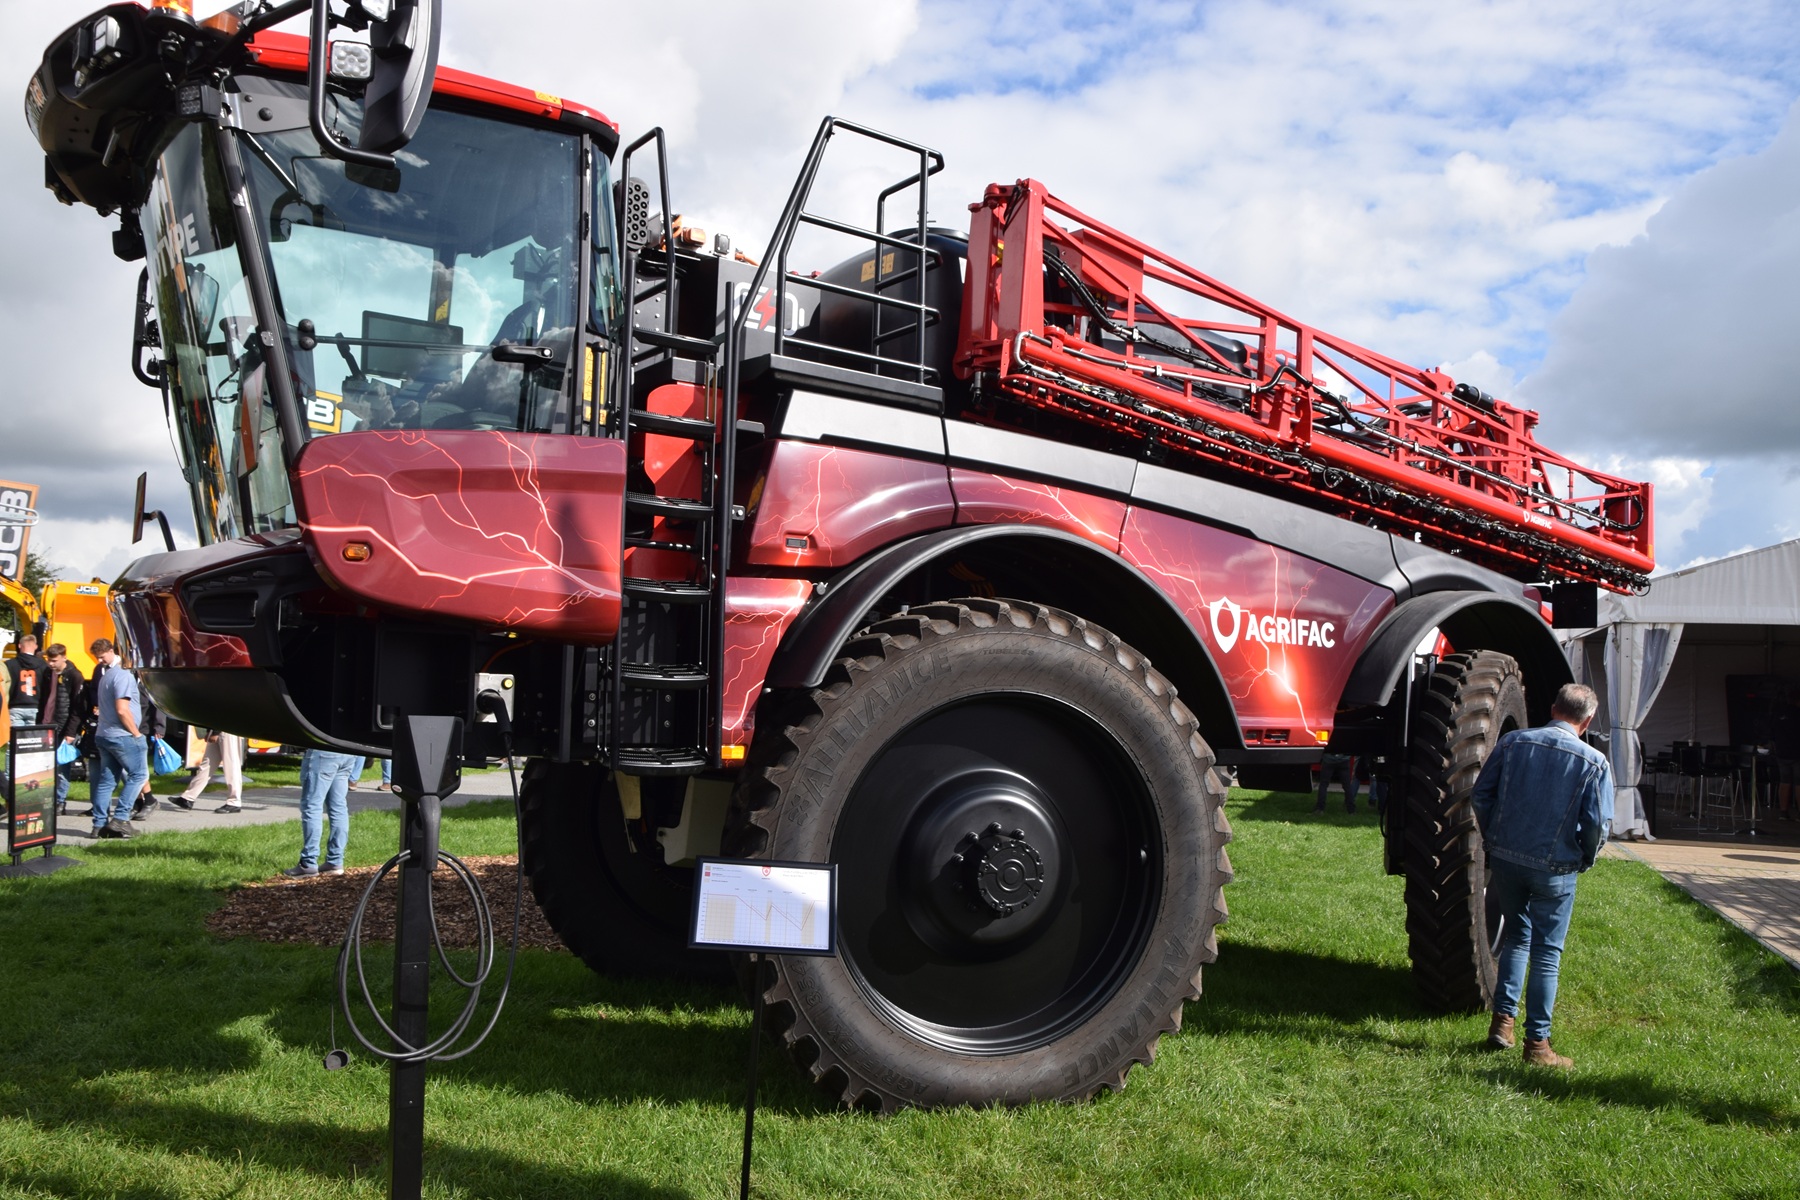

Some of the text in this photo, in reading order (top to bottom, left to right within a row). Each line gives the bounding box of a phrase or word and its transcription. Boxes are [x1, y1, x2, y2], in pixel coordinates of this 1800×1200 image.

[76, 585, 99, 593] JCB
[1245, 613, 1336, 649] AGRIFAC
[802, 646, 953, 808] ALLIANCE
[791, 959, 823, 1008] 354
[1061, 932, 1191, 1092] ALLIANCE
